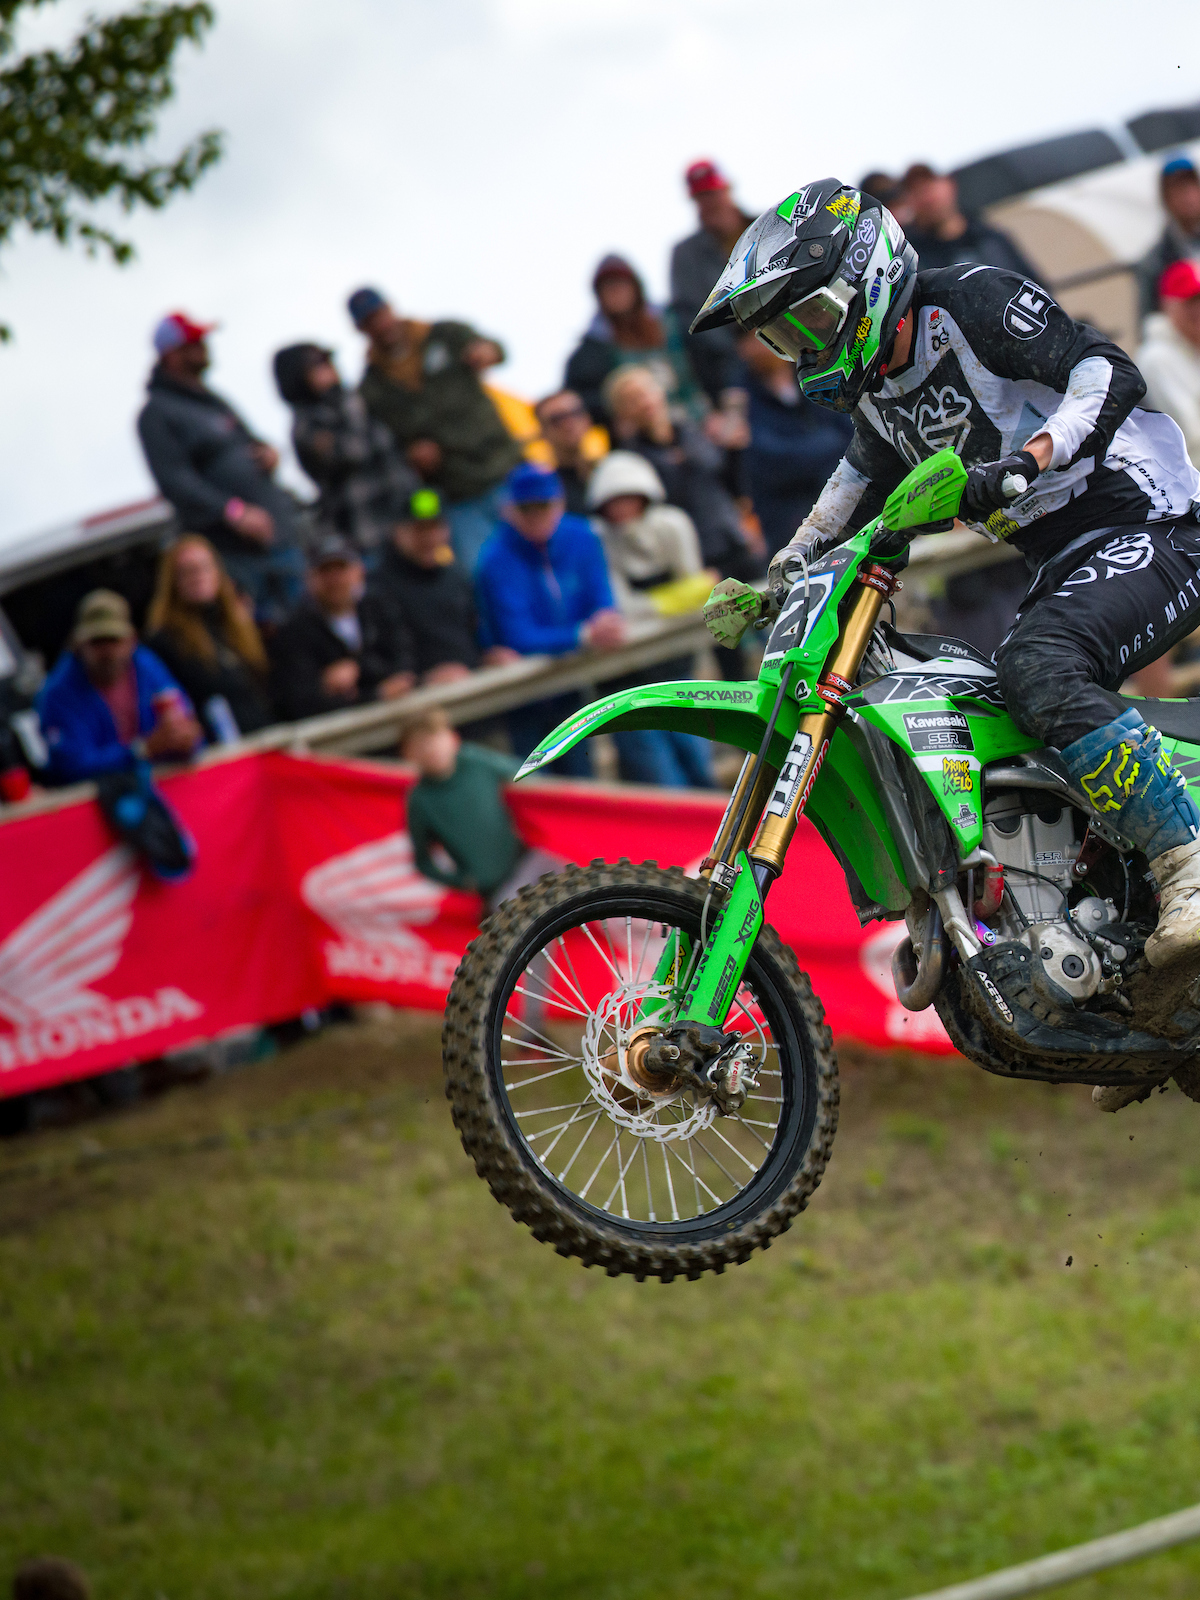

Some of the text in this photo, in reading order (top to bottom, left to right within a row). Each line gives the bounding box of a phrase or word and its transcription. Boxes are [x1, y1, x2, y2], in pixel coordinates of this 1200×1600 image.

[887, 261, 902, 281] BELL
[906, 467, 955, 504] ACERBIS
[1119, 622, 1155, 665] OGS
[676, 690, 754, 701] BACKYARD
[905, 714, 967, 730] Kawasaki
[928, 731, 960, 745] SSR
[942, 757, 970, 774] DRINK
[1035, 851, 1062, 861] SSR
[733, 899, 760, 947] XTRIG
[706, 953, 738, 1021] WISECO
[974, 969, 1014, 1024] ACERBIS
